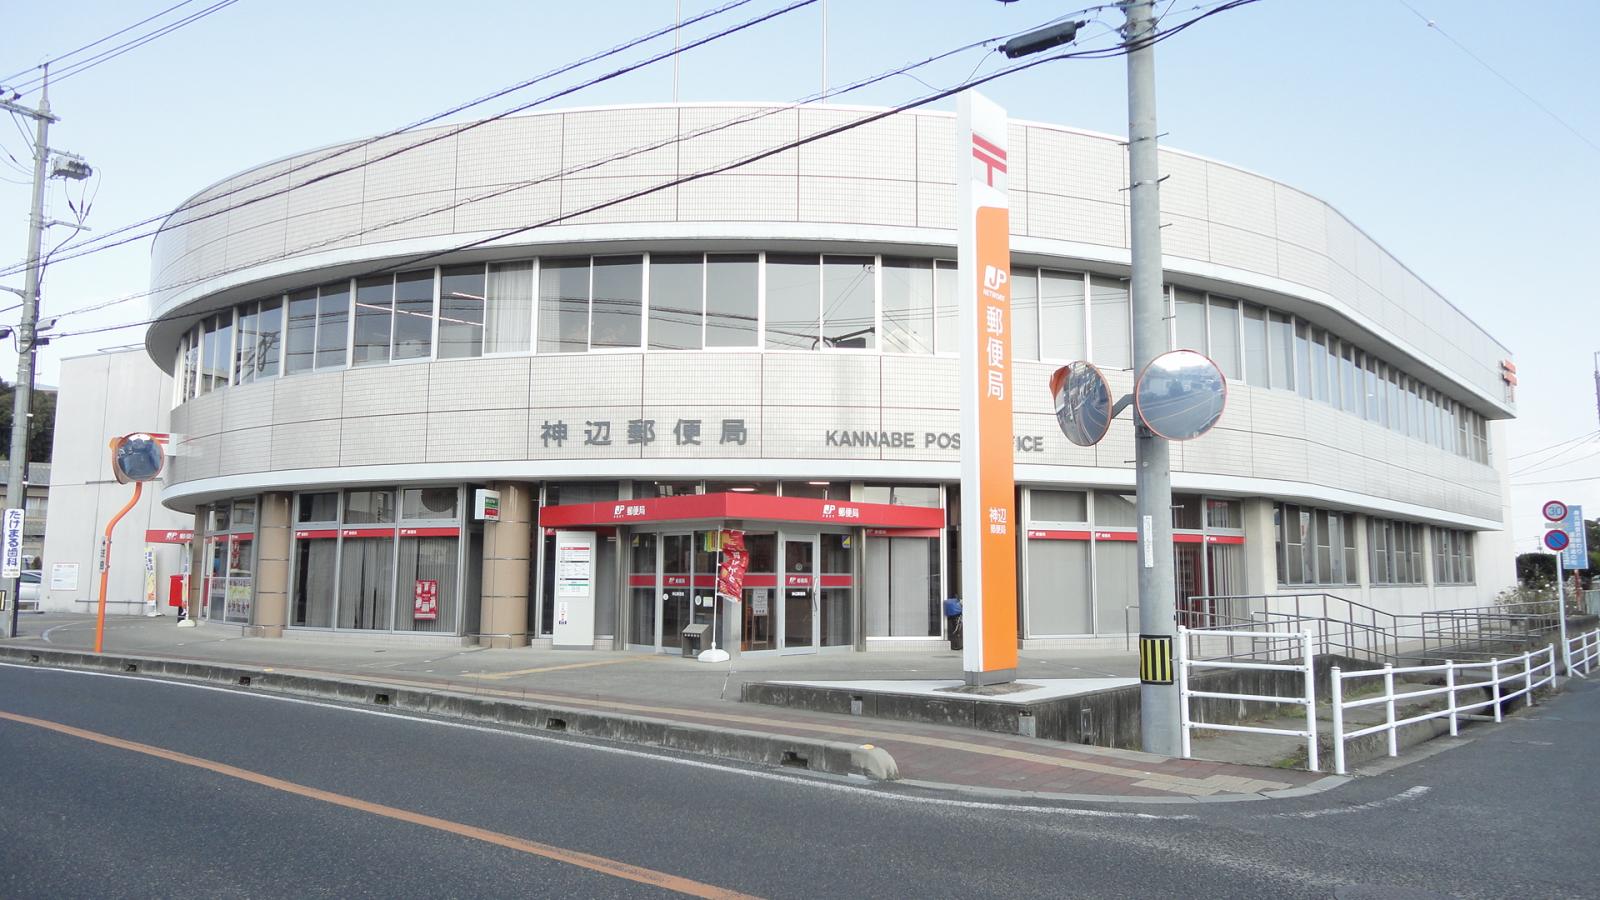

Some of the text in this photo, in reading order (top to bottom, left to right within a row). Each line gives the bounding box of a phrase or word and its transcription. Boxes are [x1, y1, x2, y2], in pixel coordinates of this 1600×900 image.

[984, 264, 1007, 290] JP
[986, 305, 1004, 401] 郵便局
[540, 418, 748, 448] 神辺郵便局
[826, 430, 915, 449] KANNABE
[925, 432, 961, 450] POS
[838, 507, 859, 518] 郵便局
[989, 506, 1008, 524] 神辺
[1547, 506, 1563, 516] 30
[7, 510, 21, 567] たけまる歯科
